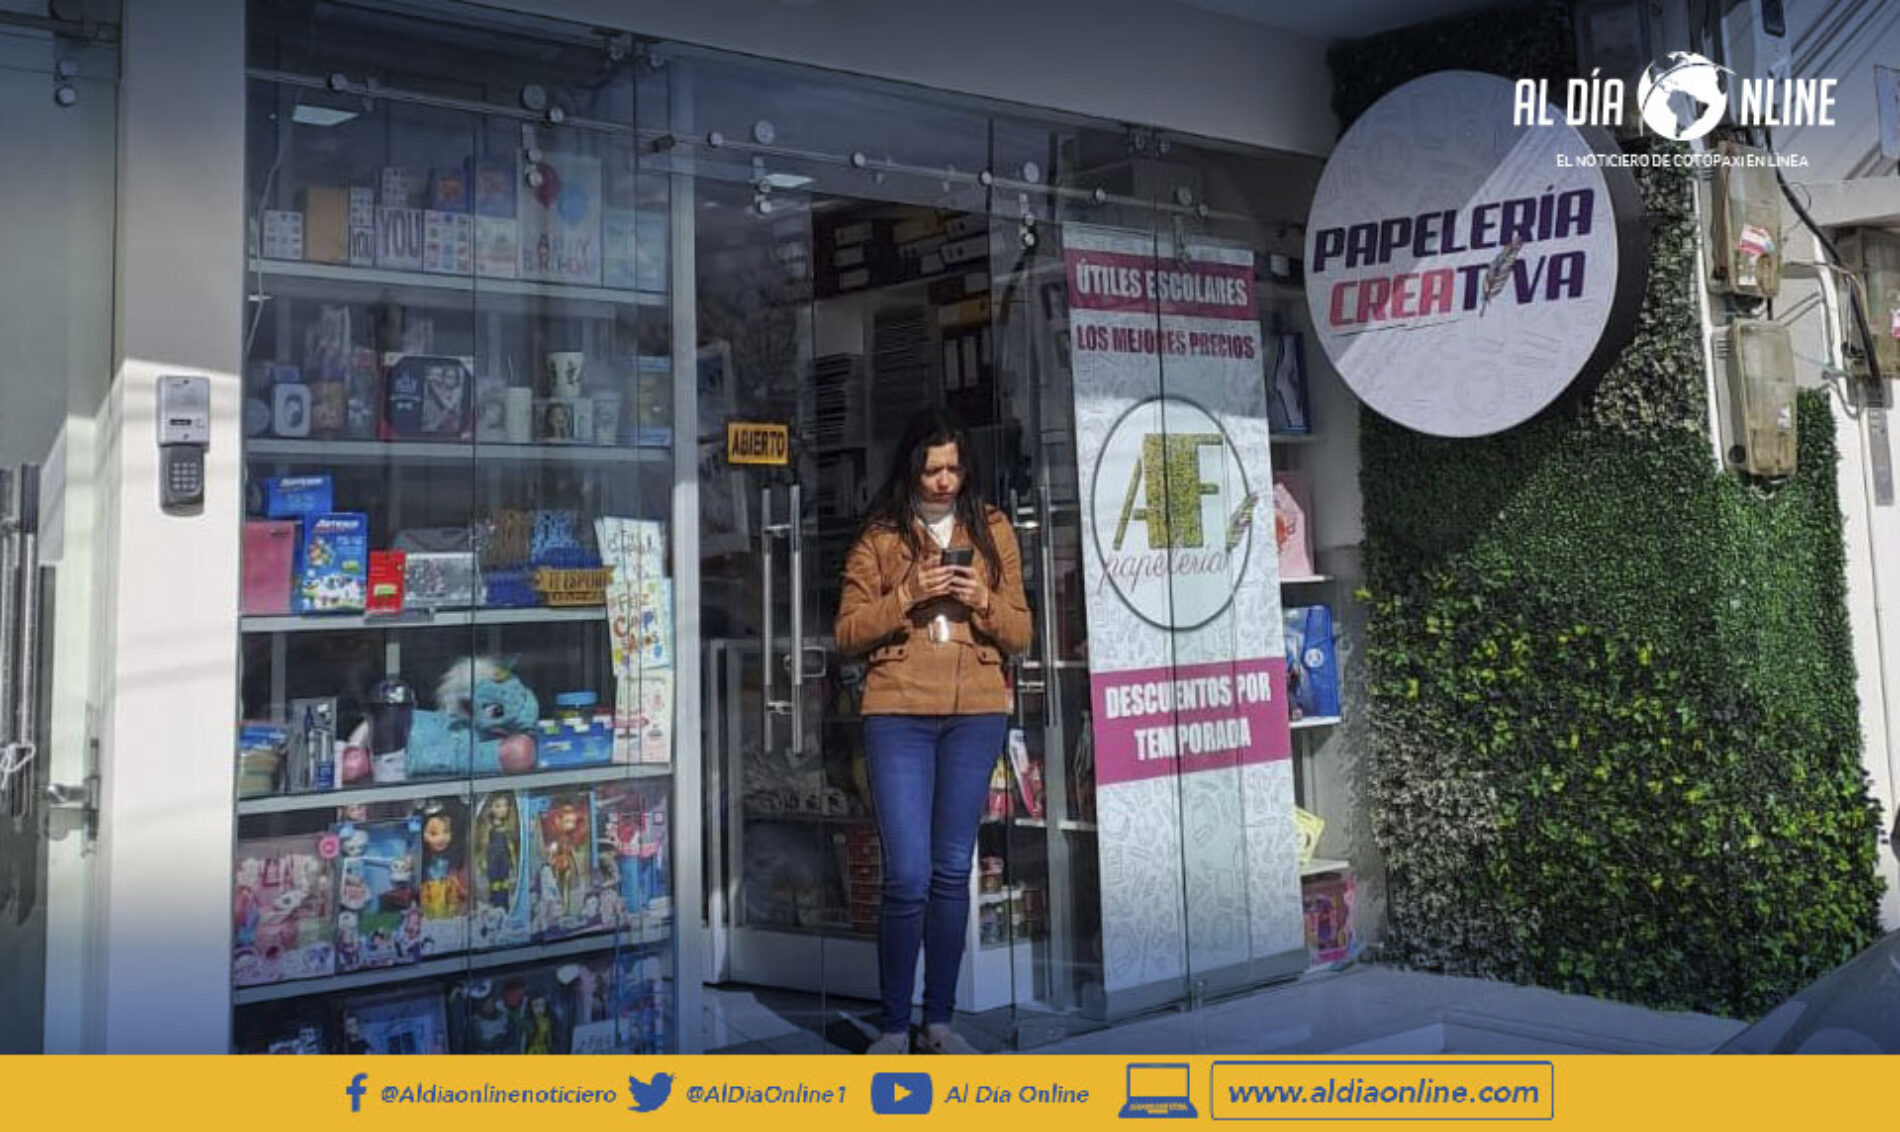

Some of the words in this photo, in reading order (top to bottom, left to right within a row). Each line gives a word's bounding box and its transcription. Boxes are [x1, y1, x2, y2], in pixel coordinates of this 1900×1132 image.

[380, 209, 421, 258] YOU
[1313, 184, 1594, 273] PAPELERÍA
[1076, 258, 1142, 298] ÚTILES
[1145, 270, 1248, 306] ESCOLARES
[1076, 324, 1109, 351] LOS
[1112, 326, 1186, 357] MEJORES
[1189, 331, 1256, 359] PRECIOS
[732, 428, 785, 458] ABIERTO
[1105, 675, 1232, 719] DESCUENTOS
[1236, 672, 1272, 705] POR
[1134, 716, 1251, 760] TEMPORADA
